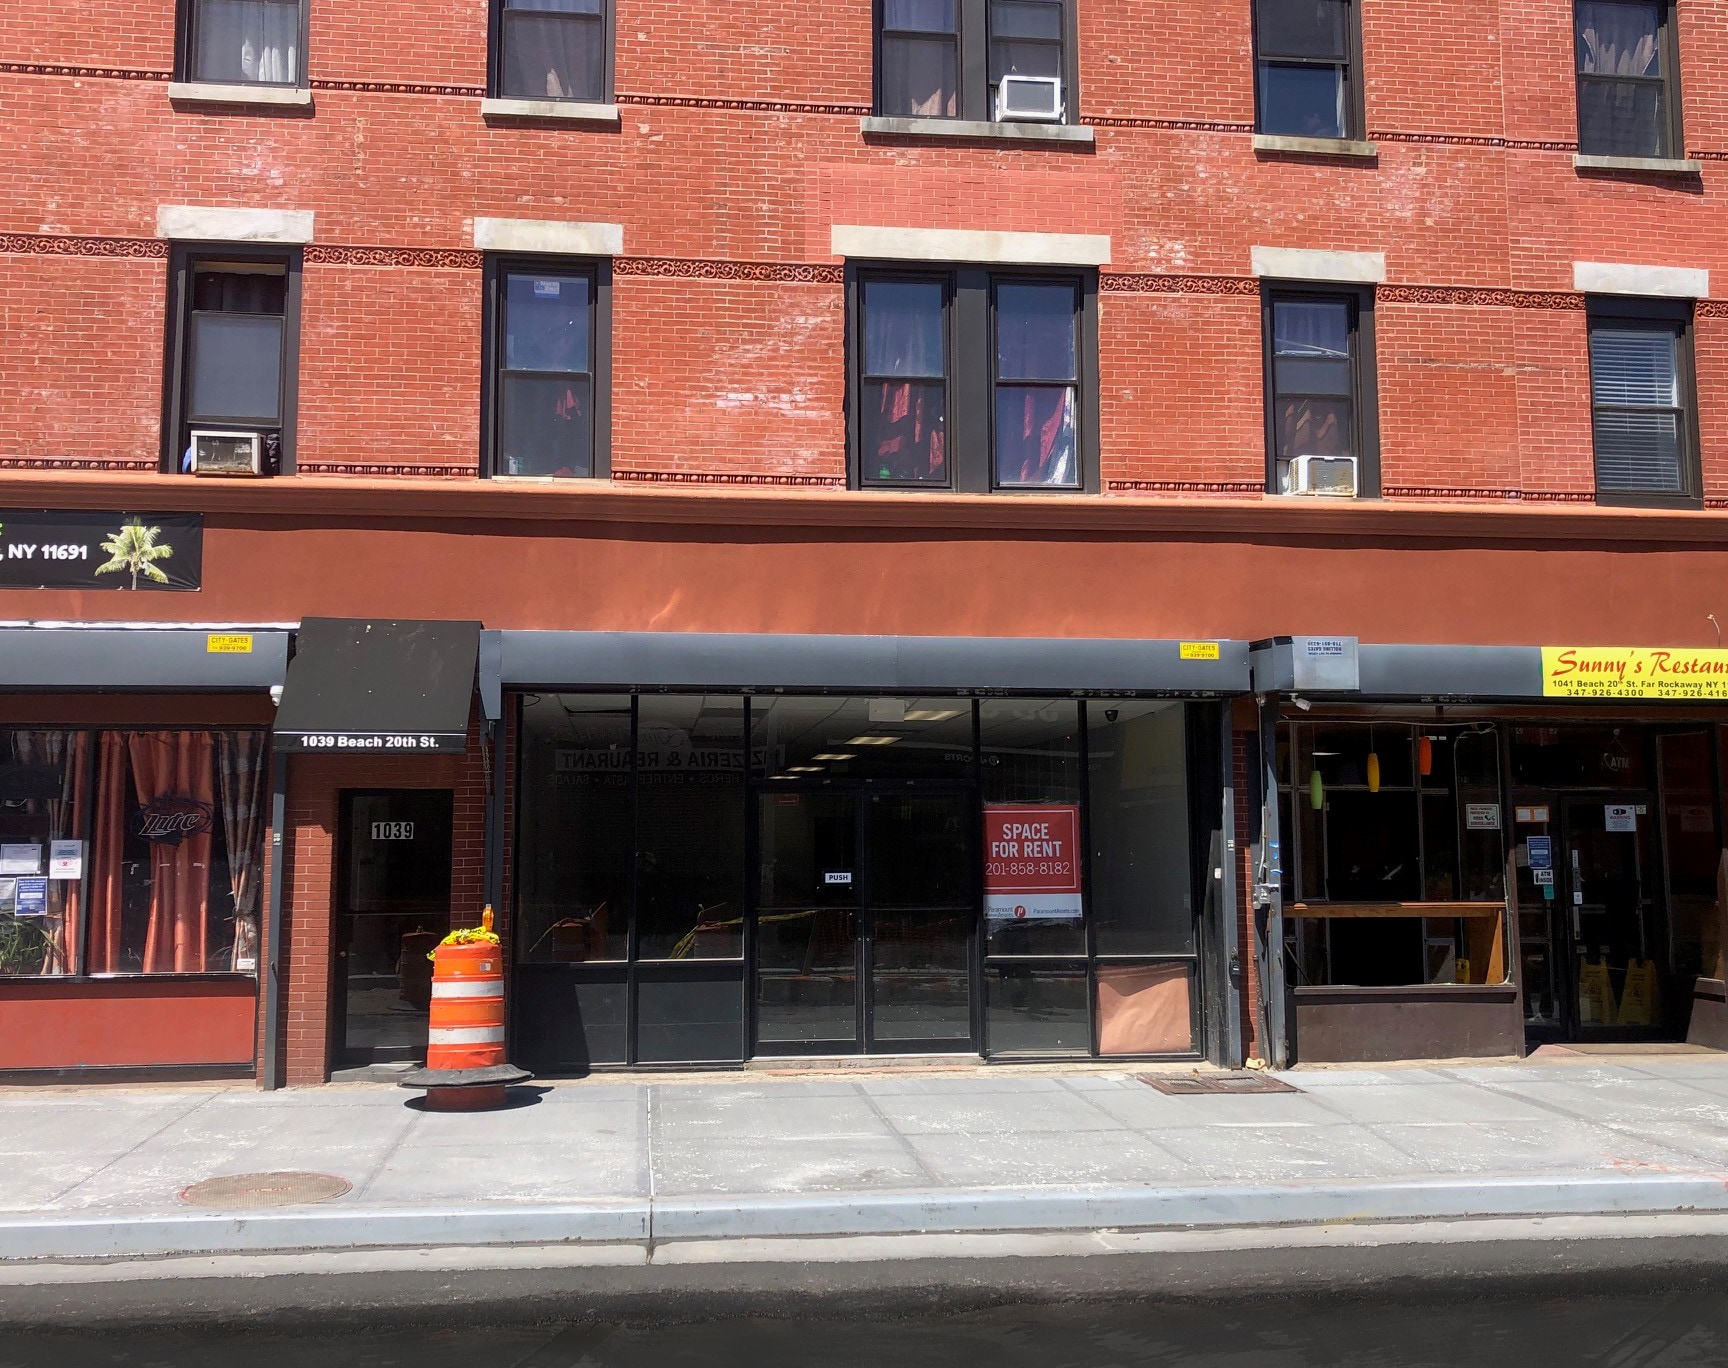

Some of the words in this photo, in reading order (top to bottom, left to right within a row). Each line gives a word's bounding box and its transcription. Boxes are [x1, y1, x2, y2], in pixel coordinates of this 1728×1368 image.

[8, 544, 36, 559] NY
[41, 545, 87, 560] 11691
[1551, 650, 1643, 681] Sunny's
[1626, 680, 1639, 688] St.
[1658, 681, 1703, 689] Rockaway
[301, 736, 335, 747] 1039
[337, 736, 382, 747] Beach
[385, 736, 416, 747] 20th
[419, 736, 439, 747] St.
[374, 822, 412, 838] 1039
[1003, 823, 1049, 839] SPACE
[992, 841, 1018, 858] FOR
[1024, 841, 1062, 857] RENT
[985, 862, 1070, 875] 201-858-8182
